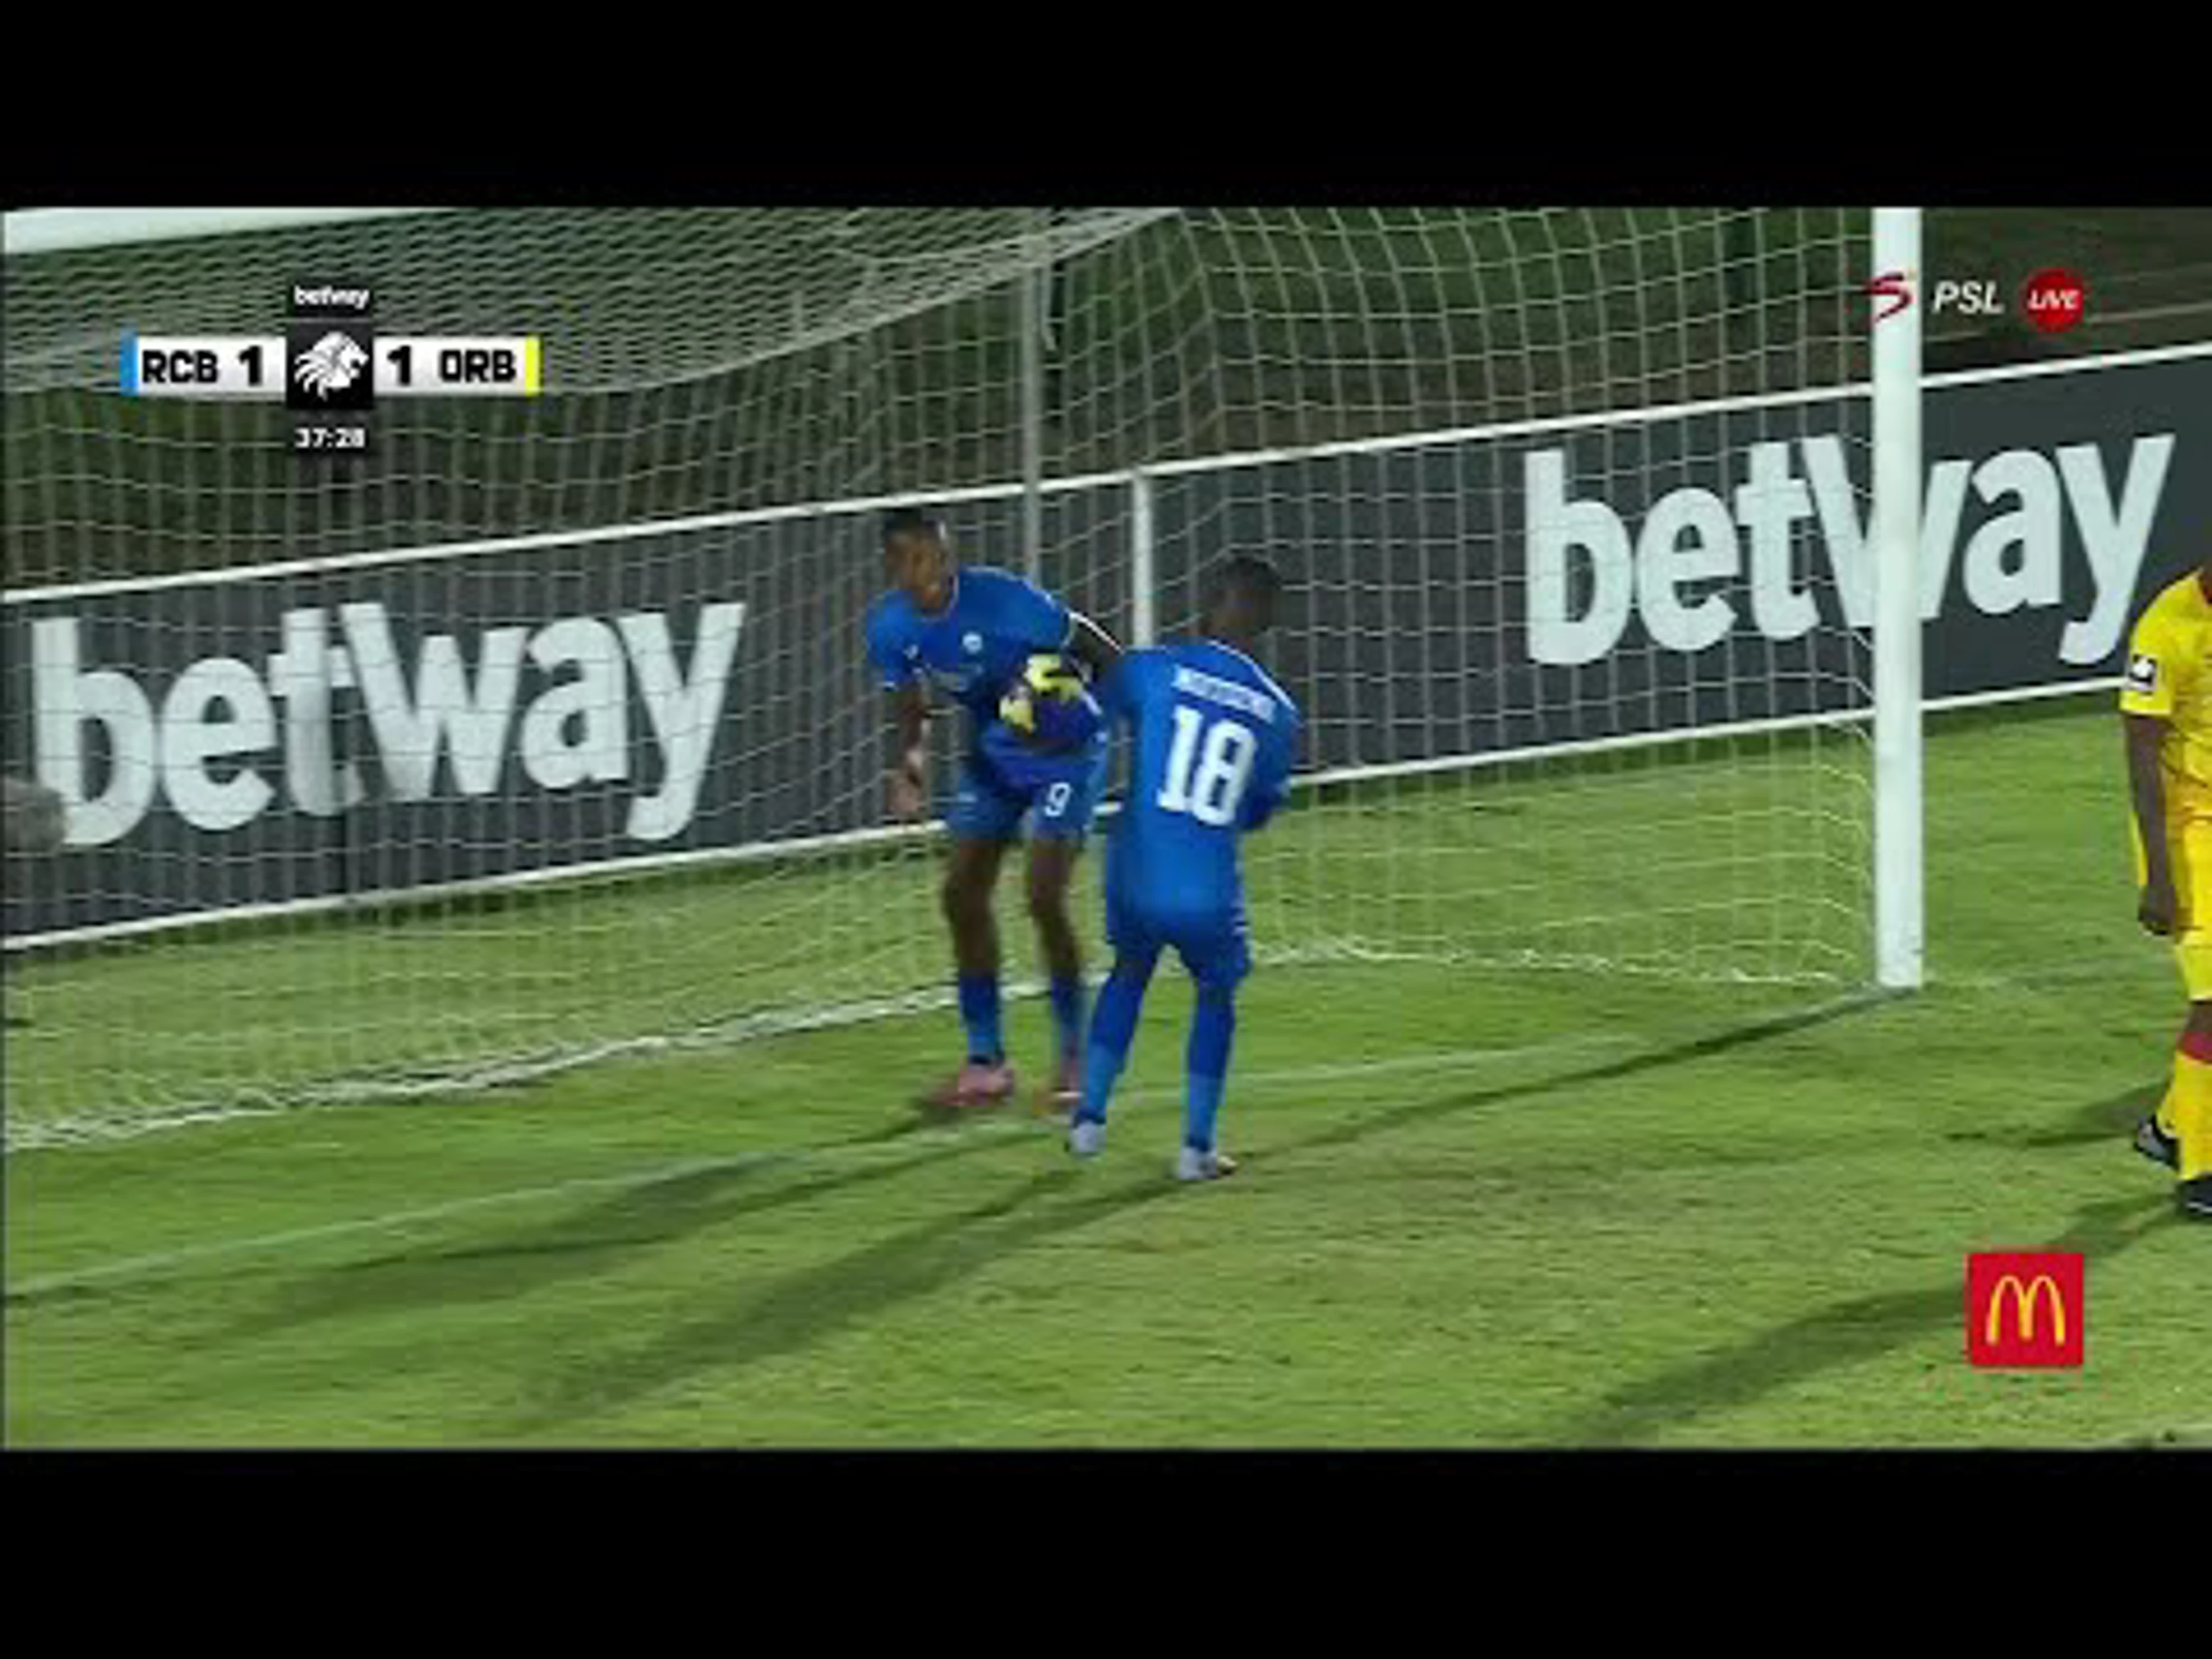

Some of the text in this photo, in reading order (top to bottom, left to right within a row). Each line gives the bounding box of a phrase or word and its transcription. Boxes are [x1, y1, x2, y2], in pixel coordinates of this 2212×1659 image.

[1524, 433, 2175, 666] betway
[32, 602, 746, 846] betway
[1044, 782, 1071, 818] 9
[1157, 704, 1257, 826] 18
